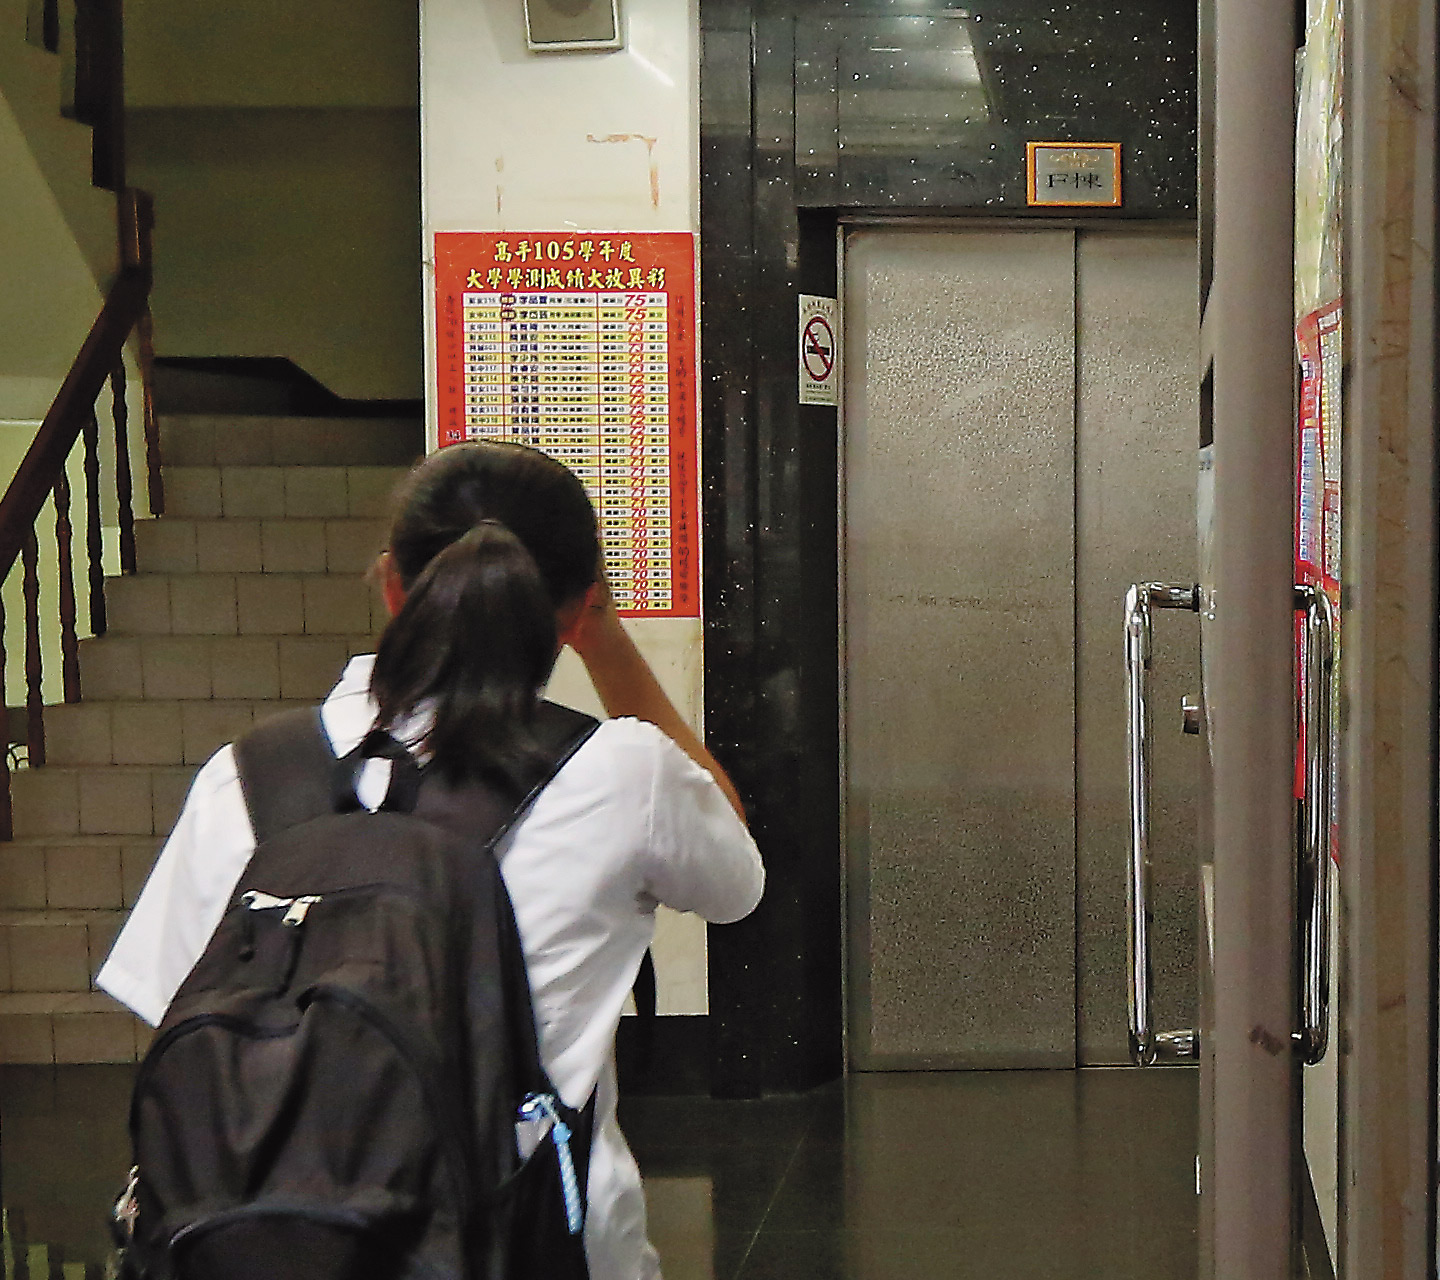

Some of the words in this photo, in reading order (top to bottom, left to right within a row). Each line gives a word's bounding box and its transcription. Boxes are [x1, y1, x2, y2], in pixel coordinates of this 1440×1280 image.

[494, 240, 636, 263] 高手105學年度
[466, 267, 666, 291] 大學學測成績大放異彩
[624, 294, 647, 306] 75
[624, 309, 647, 320] 75
